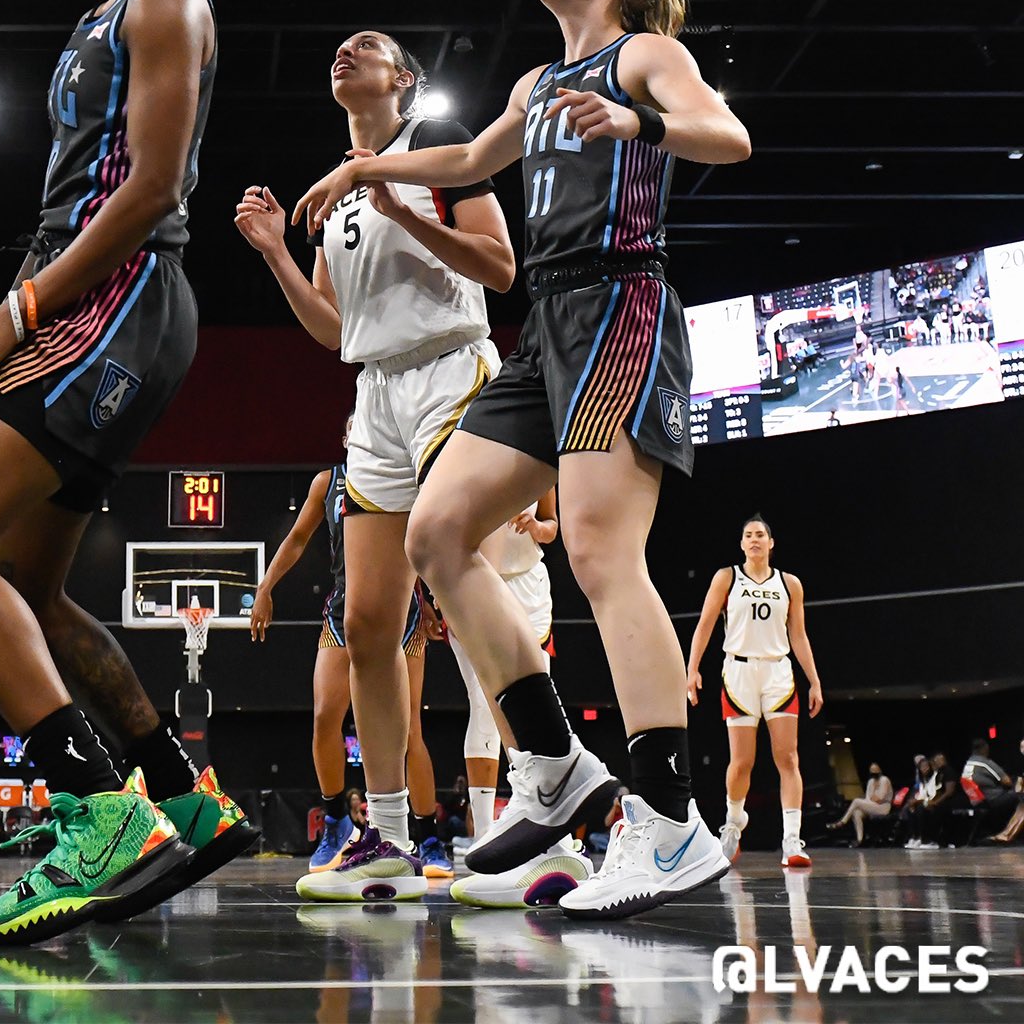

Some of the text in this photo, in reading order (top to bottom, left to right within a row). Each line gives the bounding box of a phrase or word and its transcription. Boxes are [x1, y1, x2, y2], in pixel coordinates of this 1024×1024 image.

[527, 166, 557, 219] 11
[343, 208, 362, 251] 5
[723, 303, 743, 323] 17
[184, 477, 219, 494] 2:01
[190, 494, 214, 522] 14
[741, 588, 781, 600] ACES
[751, 602, 771, 621] 10
[0, 787, 12, 800] G
